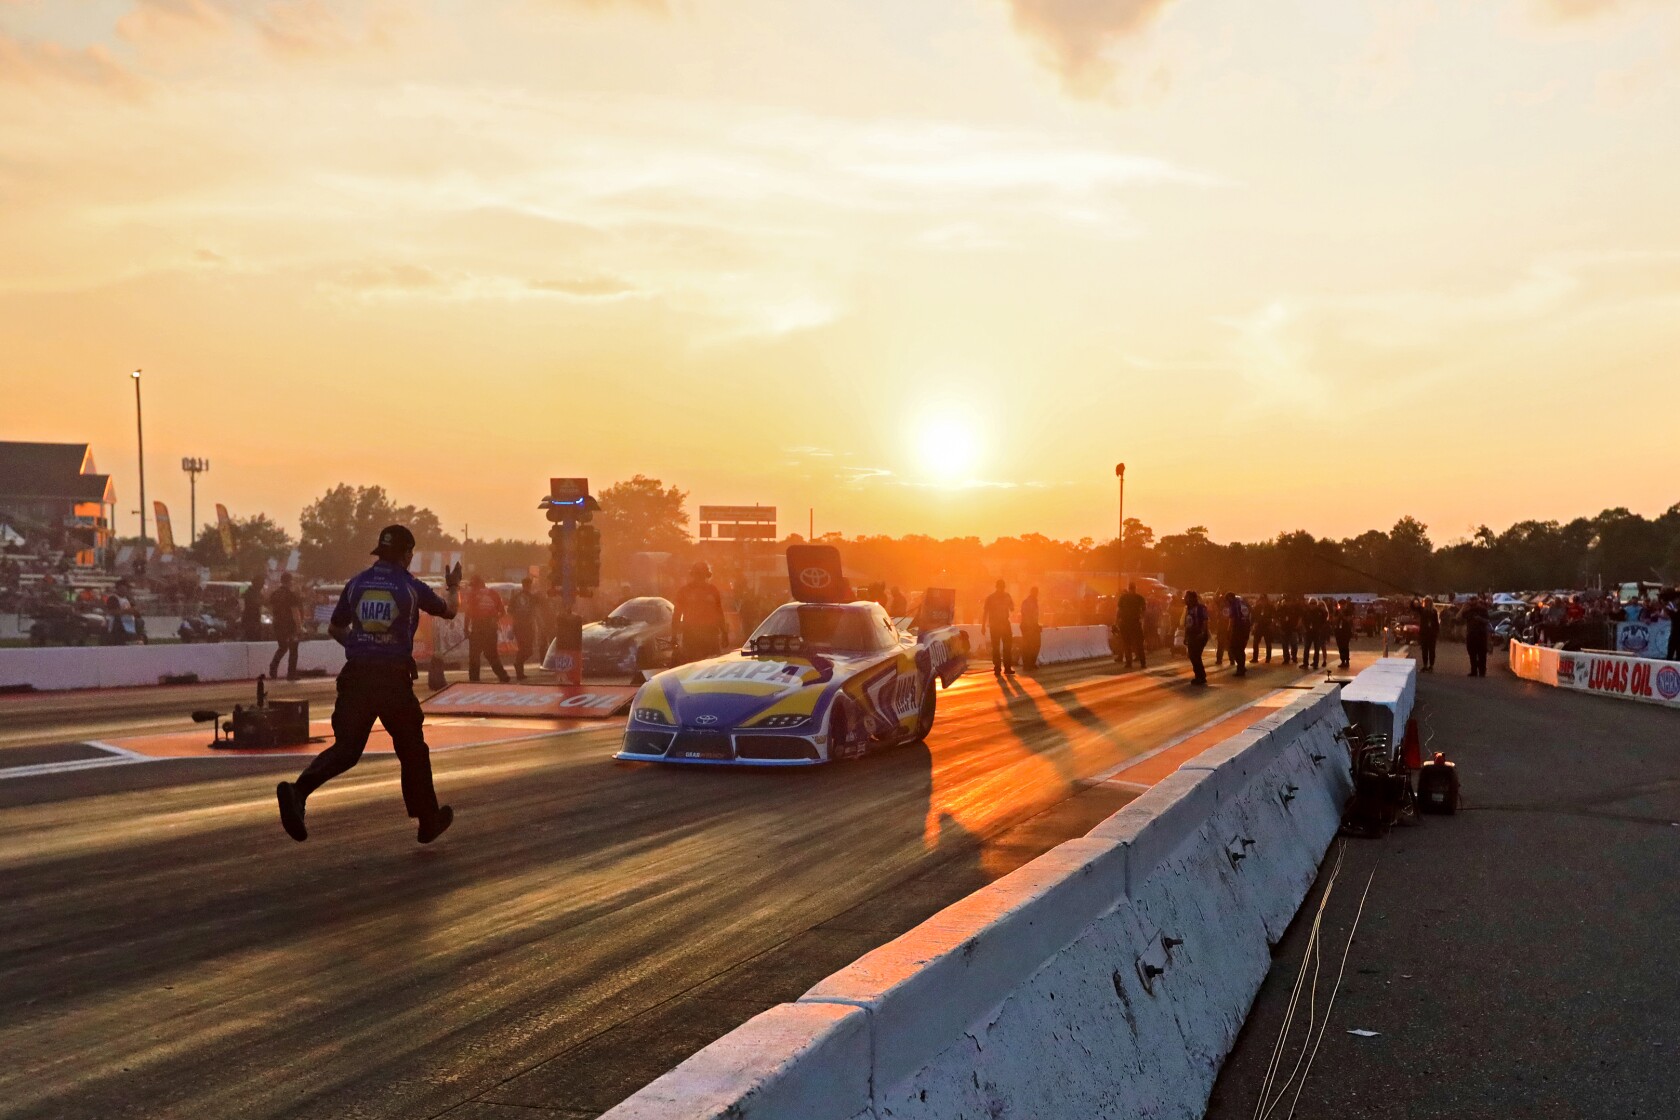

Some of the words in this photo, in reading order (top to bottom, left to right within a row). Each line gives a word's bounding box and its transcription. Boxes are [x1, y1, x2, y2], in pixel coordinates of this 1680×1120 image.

[361, 601, 391, 621] NAPA
[694, 660, 800, 684] NAPA
[1588, 658, 1629, 693] LUCAS
[1631, 662, 1653, 696] OIL
[433, 691, 563, 707] LUCAS
[559, 692, 624, 709] OIL
[896, 674, 918, 715] NAPA
